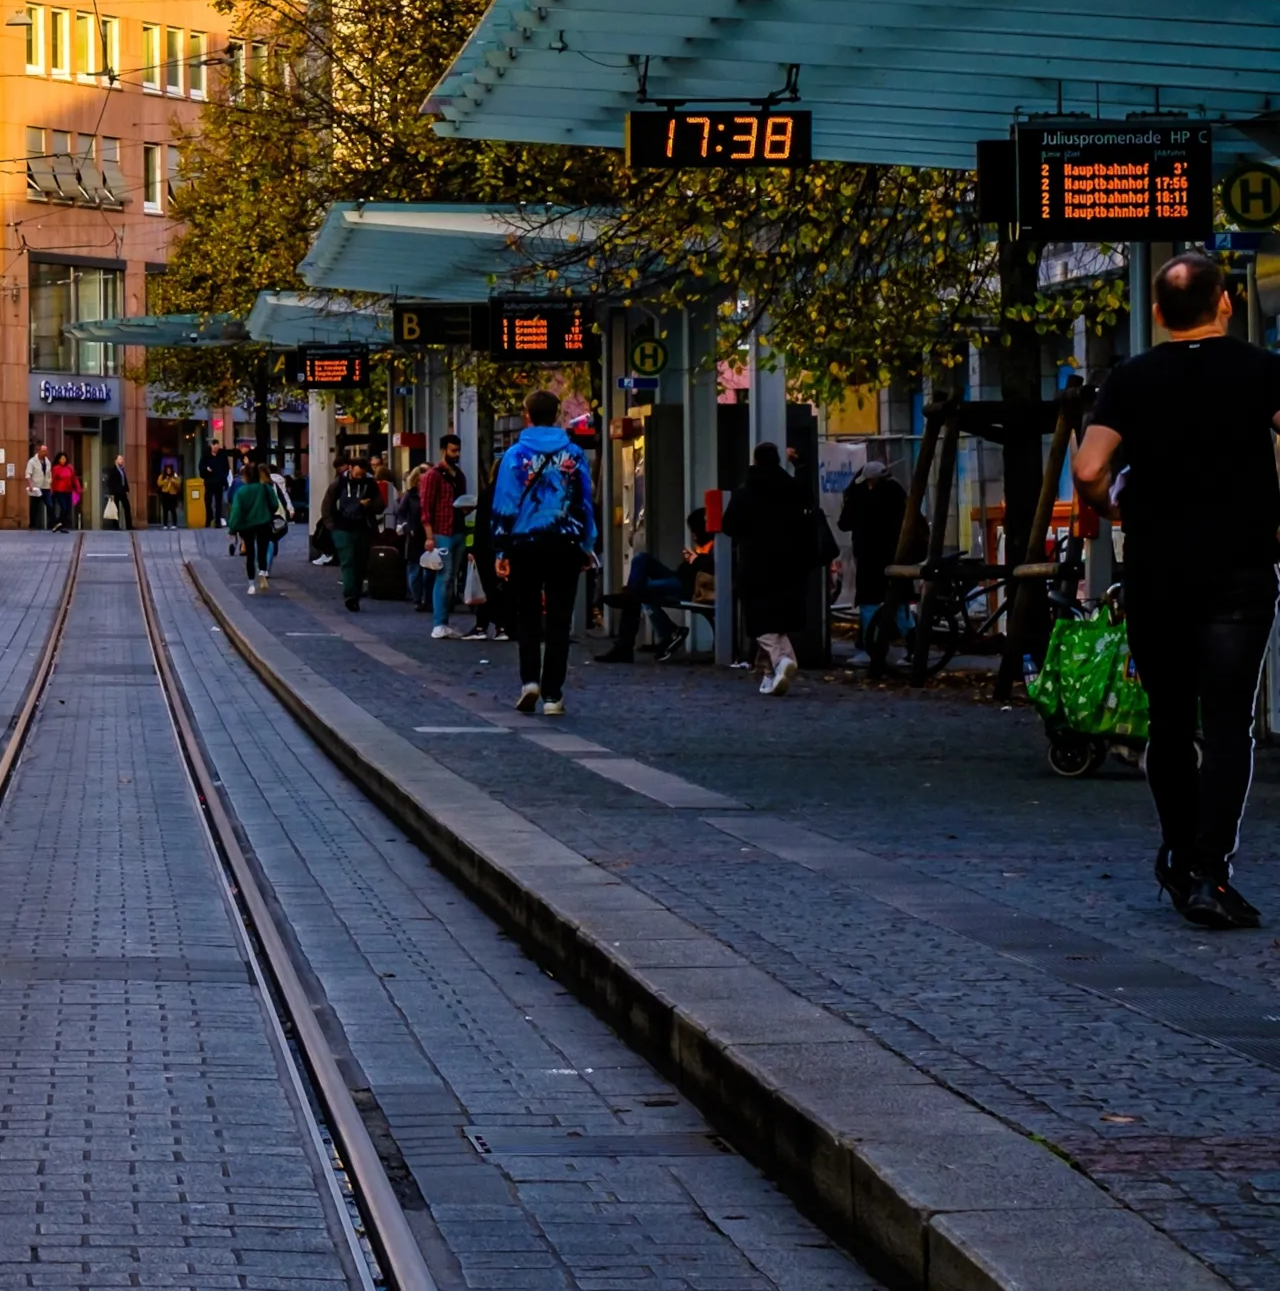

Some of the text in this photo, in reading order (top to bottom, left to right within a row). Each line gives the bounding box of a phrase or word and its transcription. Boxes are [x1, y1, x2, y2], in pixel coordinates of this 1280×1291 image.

[666, 117, 793, 159] 17:38
[1041, 130, 1208, 148] Juliuspromenade HP C
[1041, 163, 1050, 176] 2
[1064, 163, 1150, 177] Hauptbahnhof
[1041, 177, 1188, 192] 2 Hauptbahnhof 17:56
[1041, 191, 1188, 206] 2 Hauptbahnhof 18:11
[1241, 178, 1271, 214] H
[1041, 206, 1050, 218] 2
[1064, 205, 1150, 220] Hauptbahnhof
[403, 313, 421, 340] B
[640, 345, 659, 367] H
